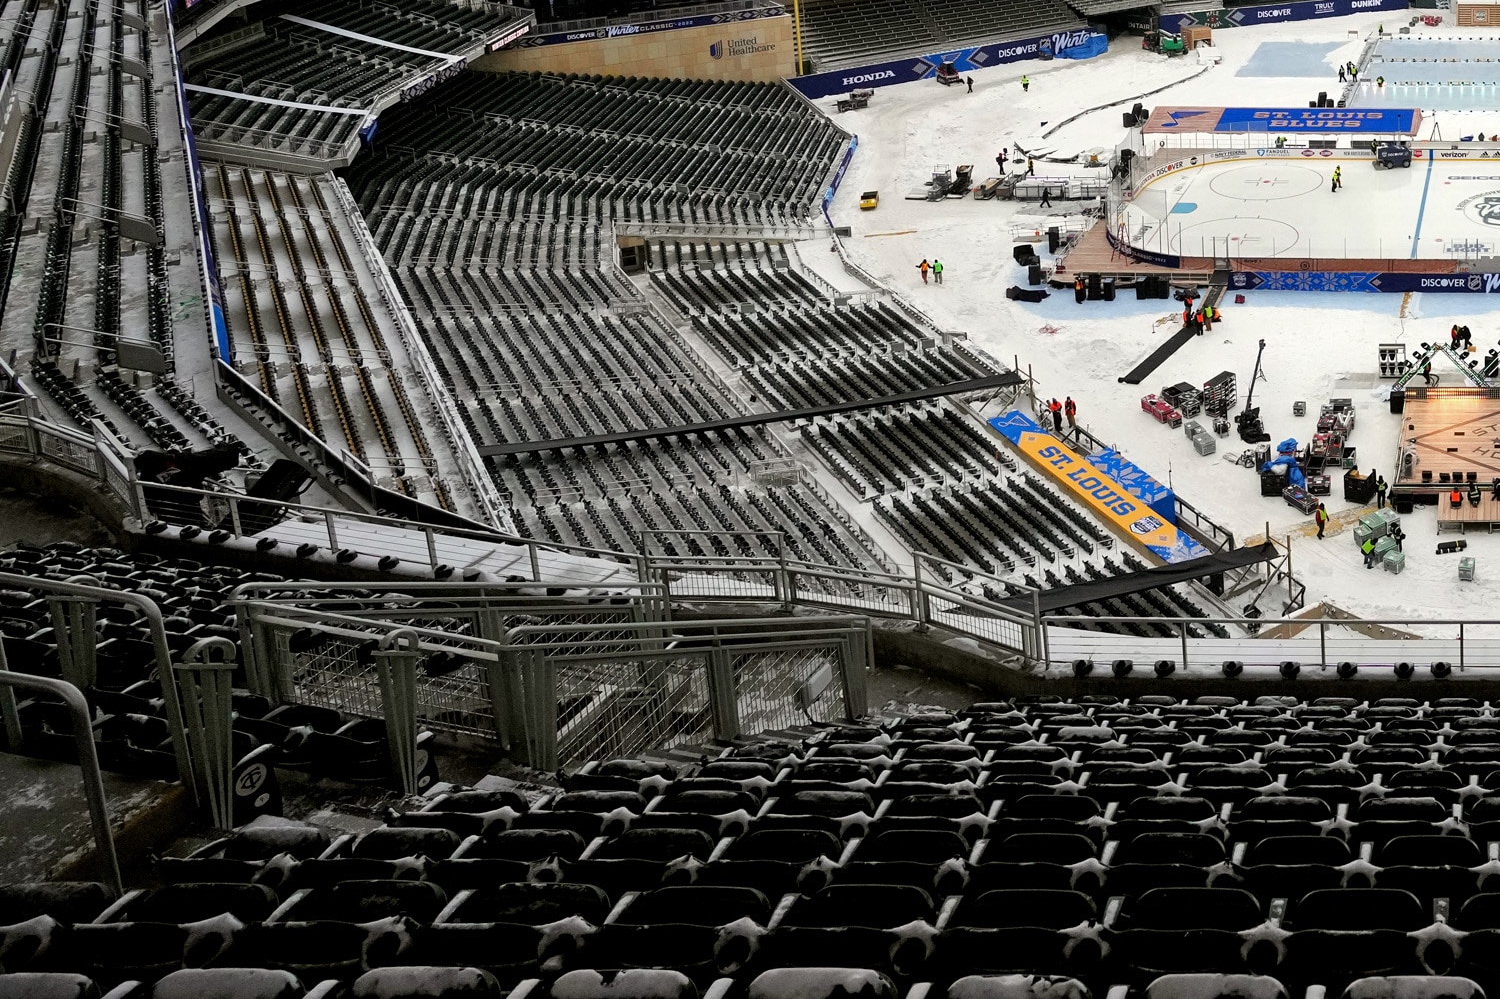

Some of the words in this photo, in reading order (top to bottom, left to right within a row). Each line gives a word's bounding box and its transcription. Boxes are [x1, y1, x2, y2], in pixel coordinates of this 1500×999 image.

[1314, 2, 1334, 10] TRULY
[1352, 0, 1383, 9] DUNKIN'
[1258, 8, 1292, 19] DISCOVER
[567, 31, 596, 41] DISCOVER
[606, 24, 640, 38] Winter
[640, 23, 674, 33] CLASSIC
[728, 37, 757, 49] United
[998, 44, 1037, 59] DISCOVER
[1052, 30, 1090, 54] Winte
[728, 44, 776, 57] Healthcare
[842, 70, 896, 85] HONDA
[1253, 111, 1292, 119] ST.
[1156, 161, 1183, 177] DISCOVER
[1422, 278, 1465, 287] DISCOVER
[1038, 445, 1070, 470] ST.
[1066, 468, 1136, 516] LOUIS
